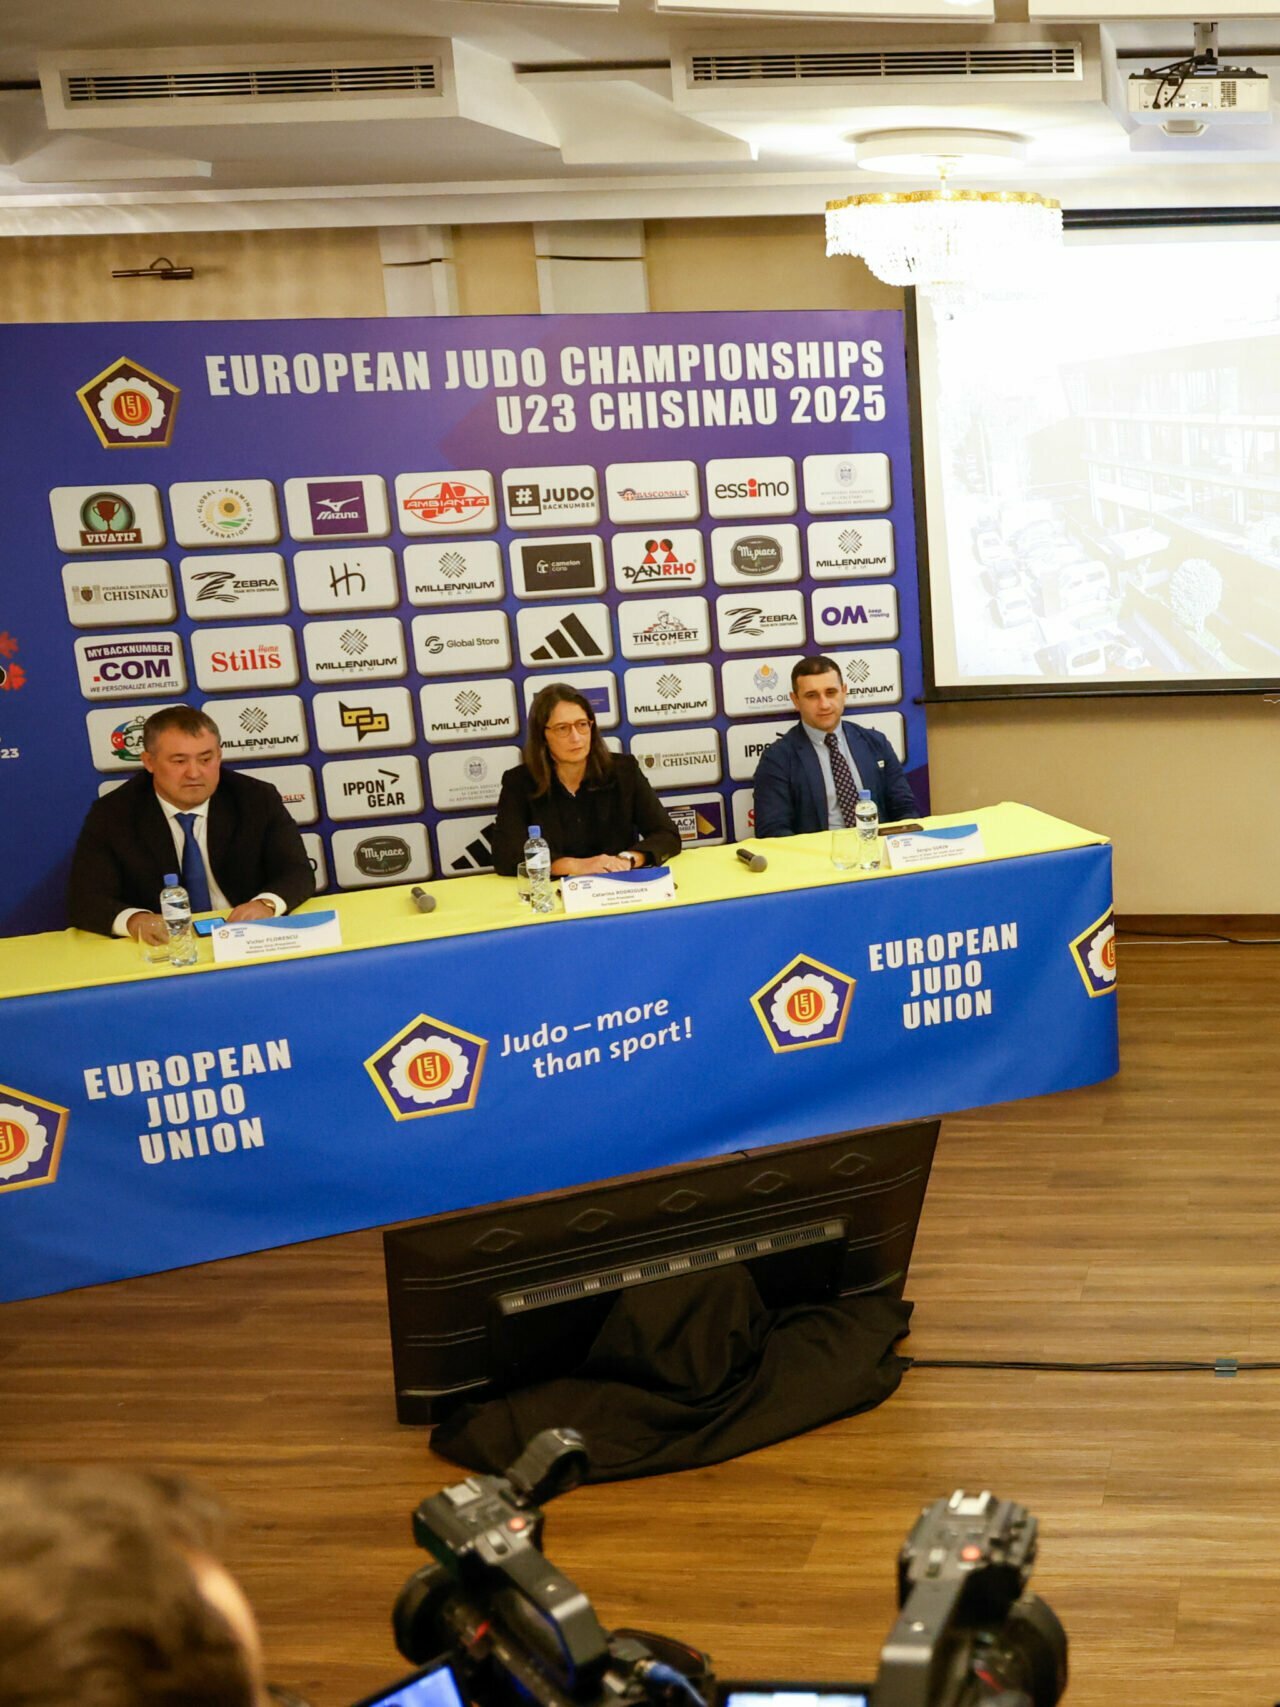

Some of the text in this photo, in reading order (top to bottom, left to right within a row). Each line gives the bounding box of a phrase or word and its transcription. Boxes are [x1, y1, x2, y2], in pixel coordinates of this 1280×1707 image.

[205, 340, 885, 396] EUROPEAN JUDO CHAMPIONSHIPS
[496, 385, 886, 434] U23 CHISINAU 2025
[542, 487, 595, 503] JUDO
[715, 478, 789, 498] essimo
[197, 487, 253, 513] GLOBAL FARMING
[406, 497, 487, 510] AMBIANTA
[542, 502, 595, 510] BACKNUMBER
[199, 517, 254, 539] INTERNATIONAL
[86, 532, 137, 544] VIVATIP
[816, 557, 886, 567] MILLENNIUM
[622, 562, 696, 582] DANRHO
[232, 579, 278, 589] ZEBRA
[415, 581, 494, 593] MILLENNIUM
[759, 613, 798, 623] ZEBRA
[821, 605, 868, 626] OM
[446, 637, 500, 649] Global Store
[632, 631, 699, 643] TINCOMERT
[211, 649, 281, 672] Stilis
[316, 658, 397, 671] MILLENNIUM
[102, 683, 146, 692] PERSONALIZE
[147, 681, 179, 689] ATHLETES
[634, 701, 708, 714] MILLENNIUM
[431, 718, 510, 731] MILLENNIUM
[343, 780, 385, 797] IPPON
[367, 792, 405, 808] GEAR
[869, 922, 1018, 972] EUROPEAN
[910, 960, 982, 997] JUDO
[903, 989, 992, 1030] UNION
[501, 999, 669, 1056] Judo more
[84, 1038, 292, 1100] EUROPEAN
[533, 1048, 600, 1079] than
[147, 1083, 246, 1128] JUDO
[139, 1117, 265, 1164] UNION
